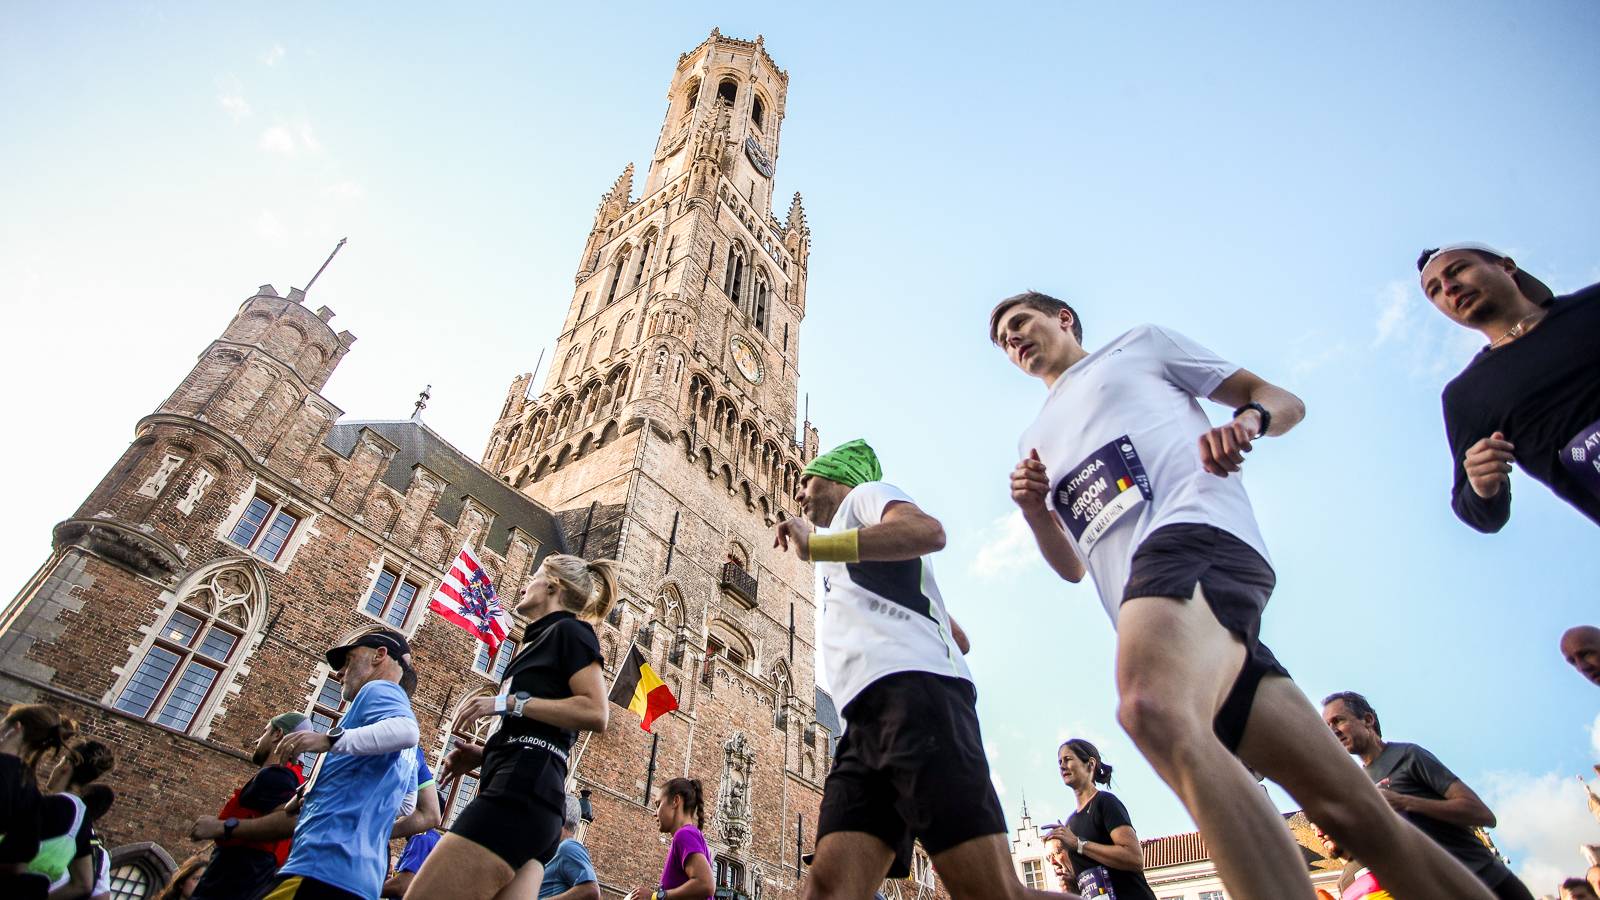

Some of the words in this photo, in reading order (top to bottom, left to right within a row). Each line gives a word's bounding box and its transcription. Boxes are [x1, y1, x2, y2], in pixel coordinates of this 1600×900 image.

[1067, 459, 1104, 495] ATHORA
[1071, 477, 1107, 519] JEROOM
[519, 735, 546, 748] CARDIO
